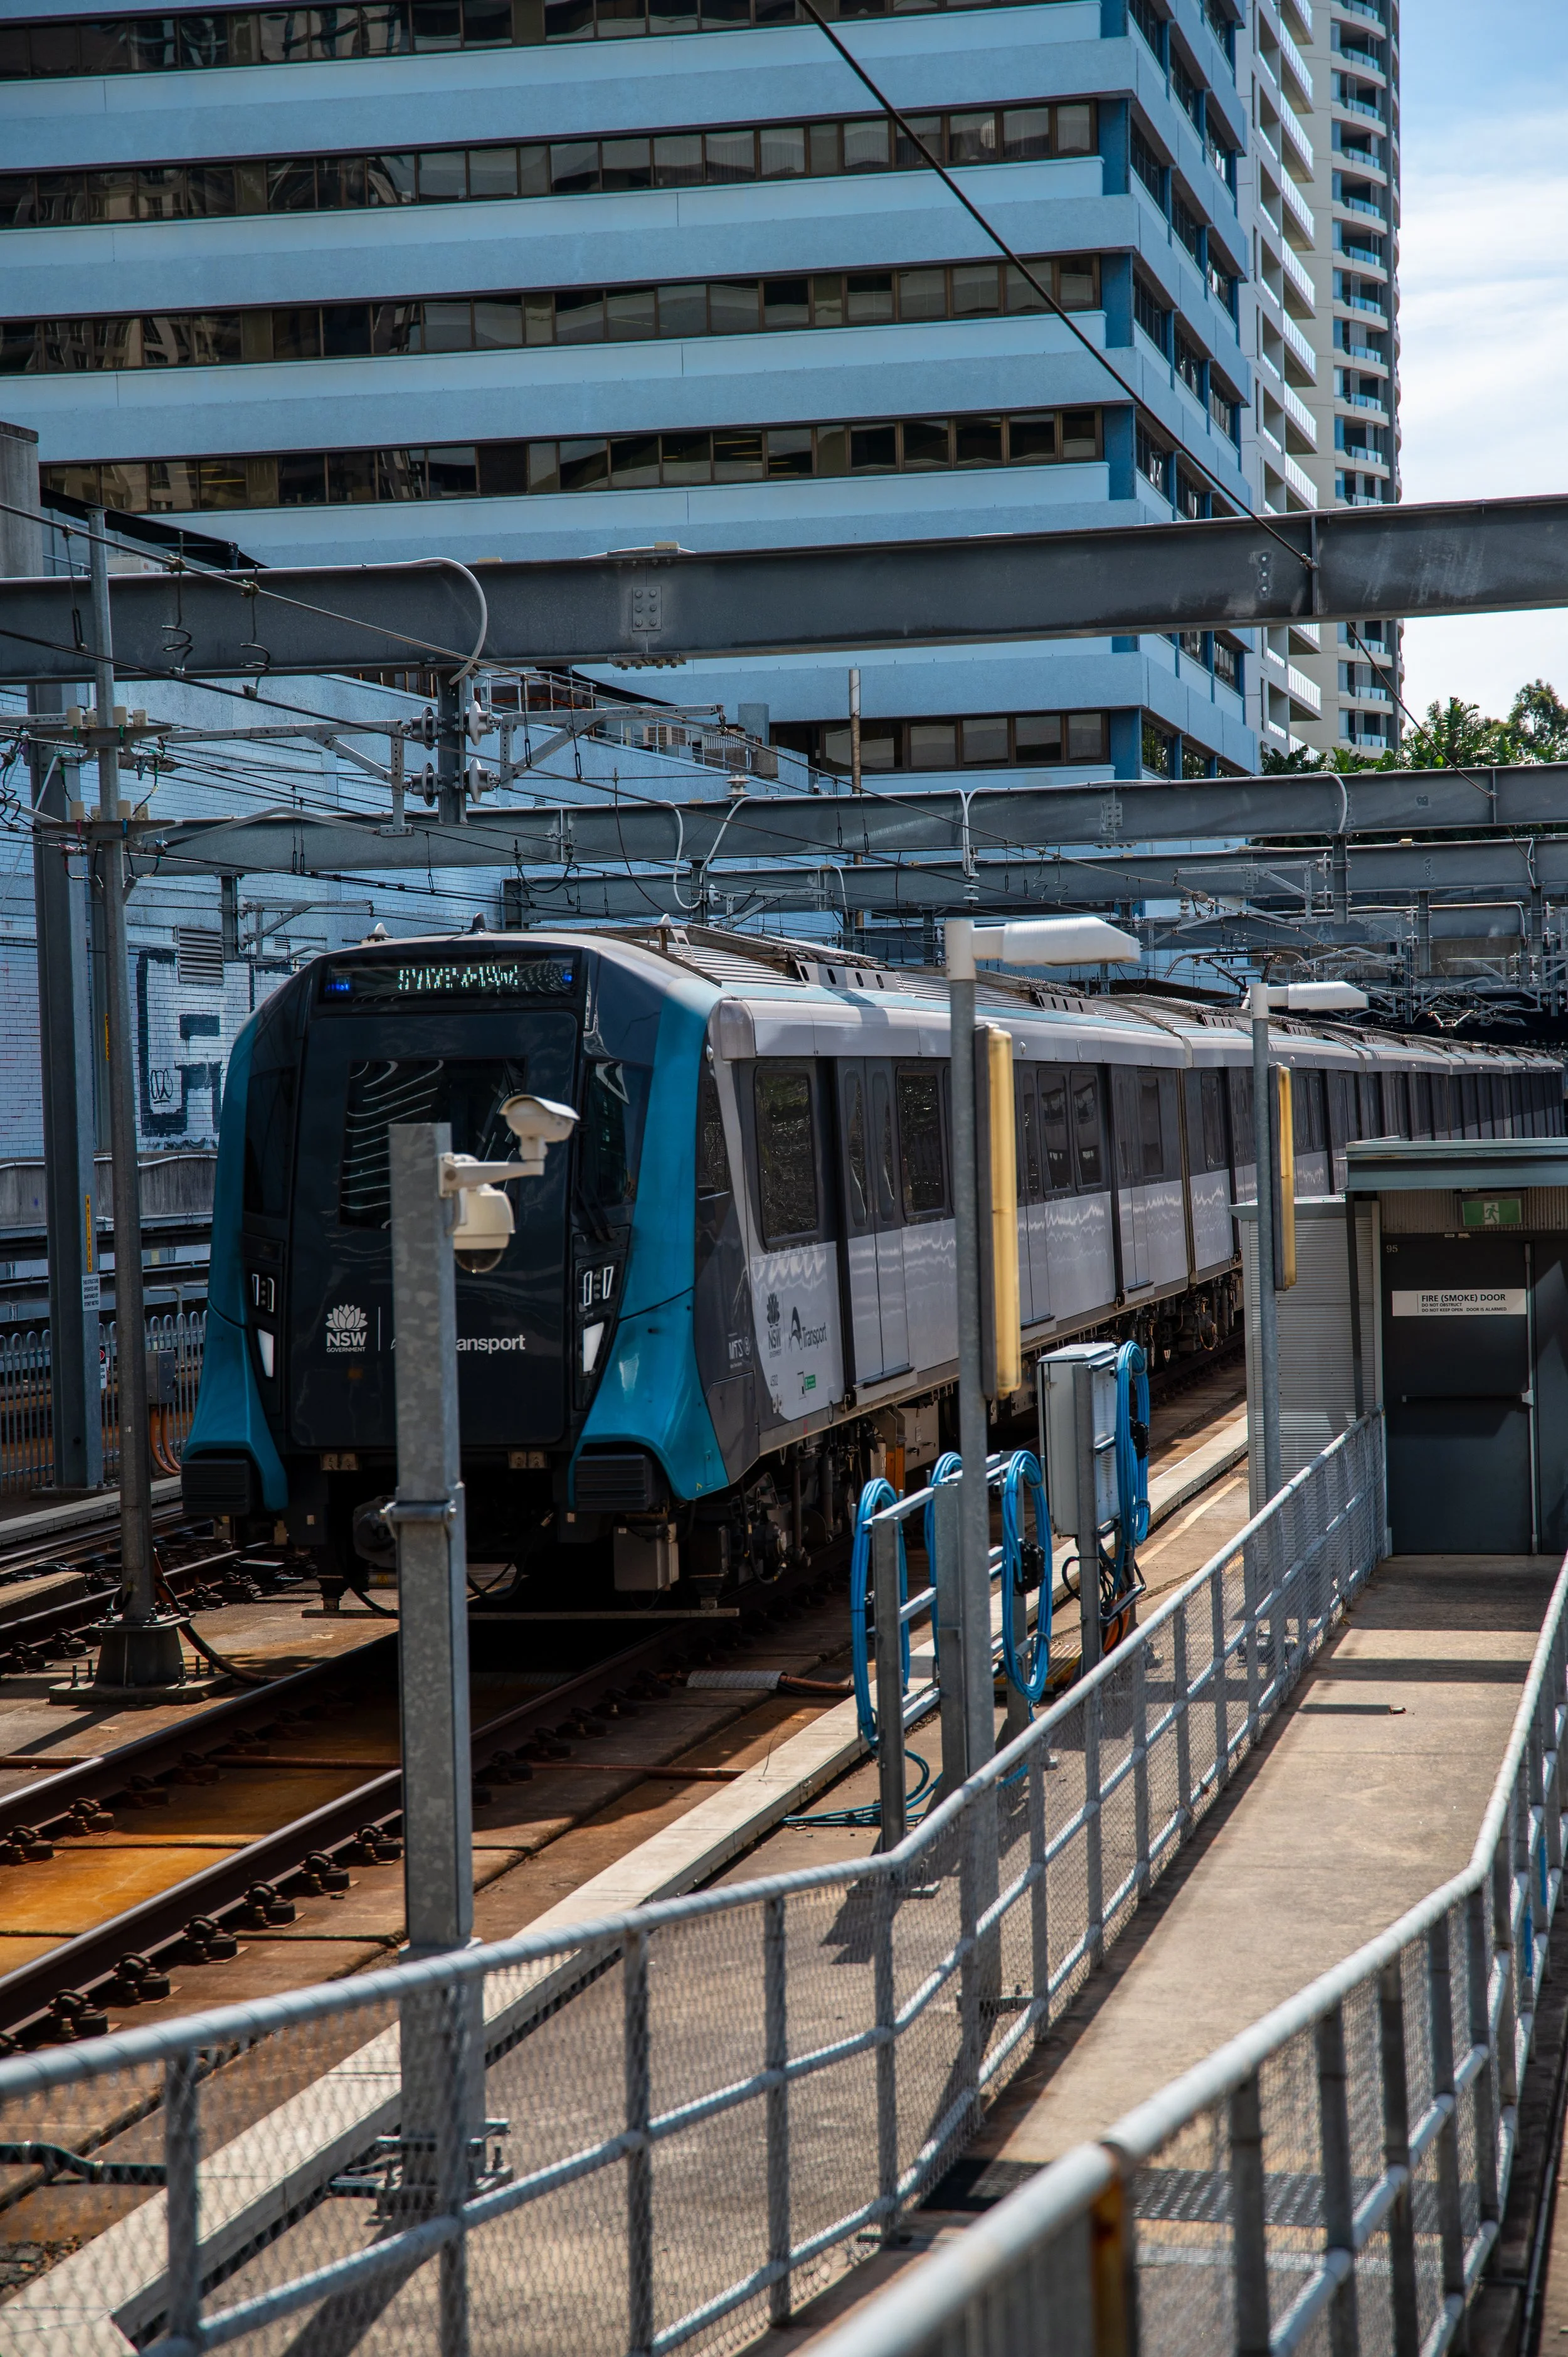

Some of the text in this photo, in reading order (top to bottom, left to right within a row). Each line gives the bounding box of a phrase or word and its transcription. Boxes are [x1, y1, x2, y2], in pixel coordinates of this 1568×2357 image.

[1386, 1244, 1399, 1253] 95
[1441, 1294, 1478, 1303] (SMOKE)
[1480, 1294, 1506, 1302] DOOR
[326, 1332, 367, 1347] NSW
[768, 1327, 781, 1350] NSW
[802, 1321, 827, 1349] Transport
[456, 1334, 526, 1354] ansport
